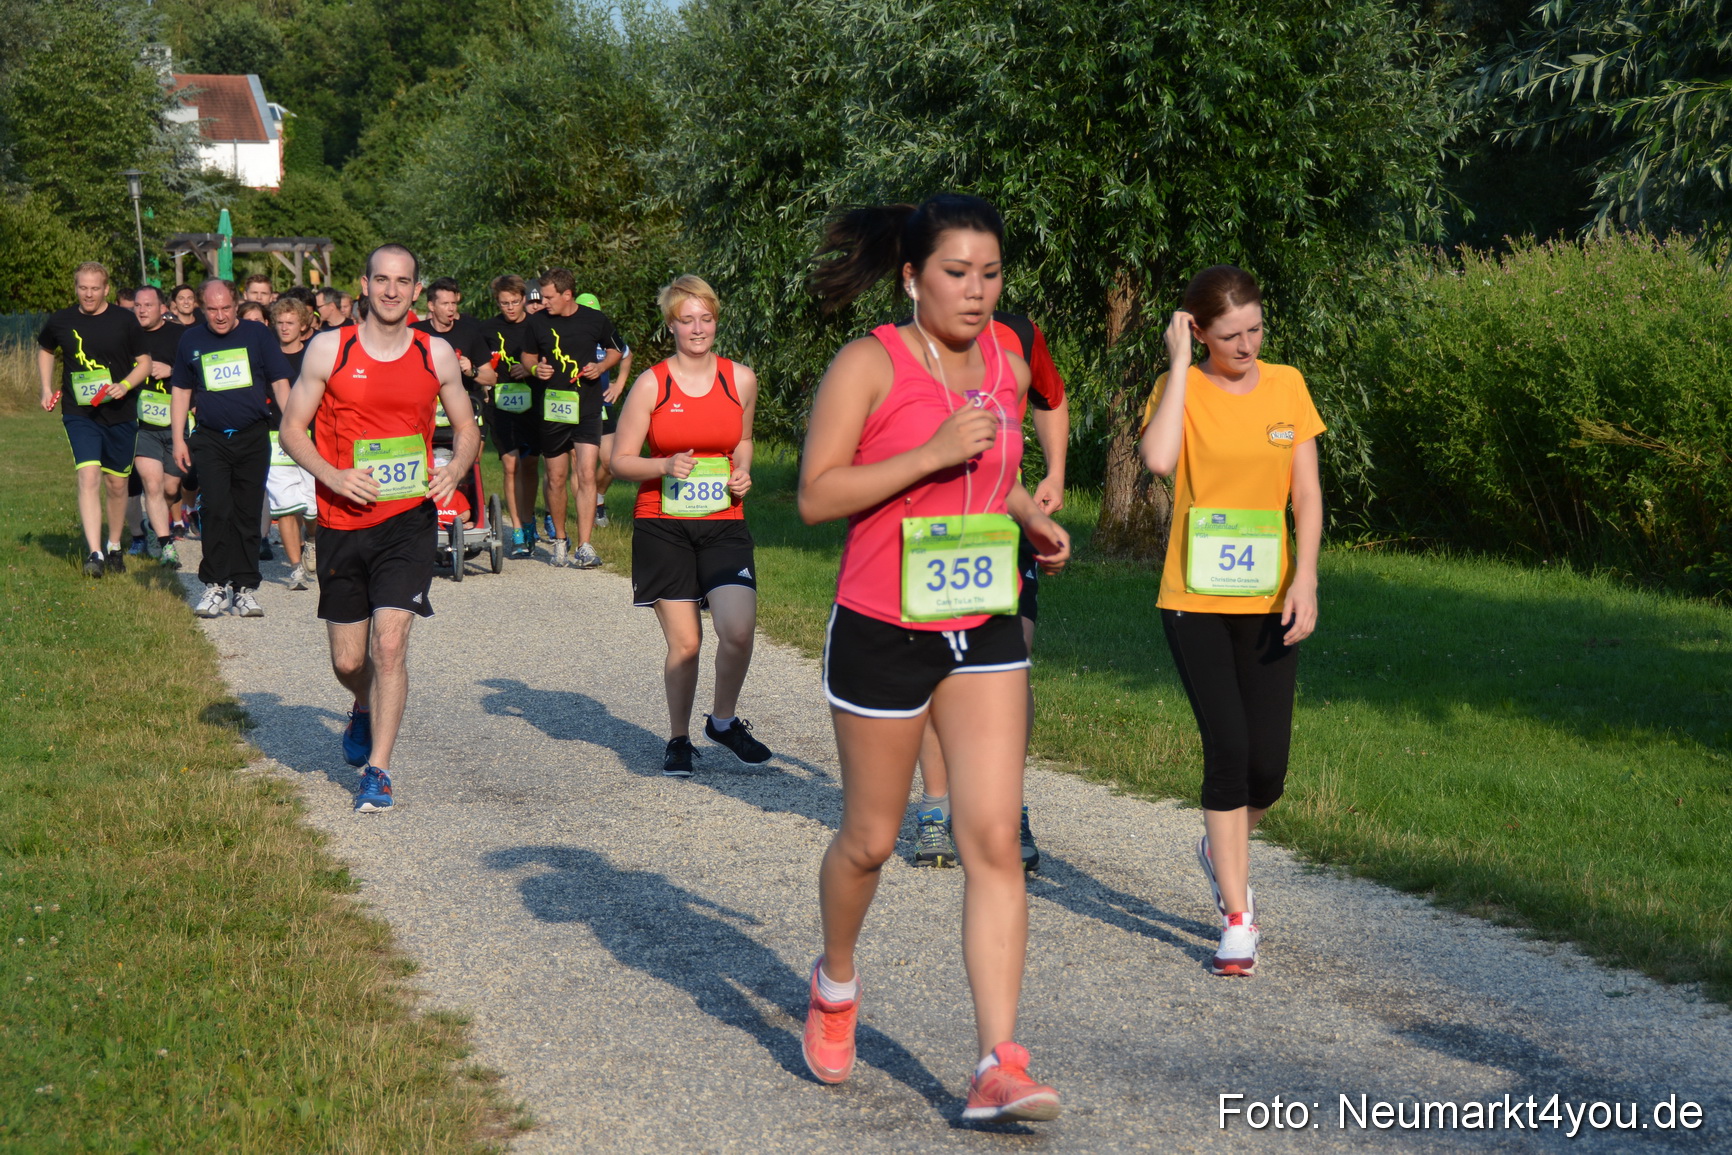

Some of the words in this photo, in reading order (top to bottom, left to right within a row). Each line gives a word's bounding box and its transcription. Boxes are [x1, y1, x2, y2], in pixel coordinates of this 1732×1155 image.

[213, 364, 242, 380] 204
[502, 395, 525, 406] 241
[550, 402, 572, 415] 245
[143, 404, 167, 417] 234
[670, 481, 724, 501] 1388
[1218, 544, 1255, 572] 54
[926, 555, 994, 592] 358
